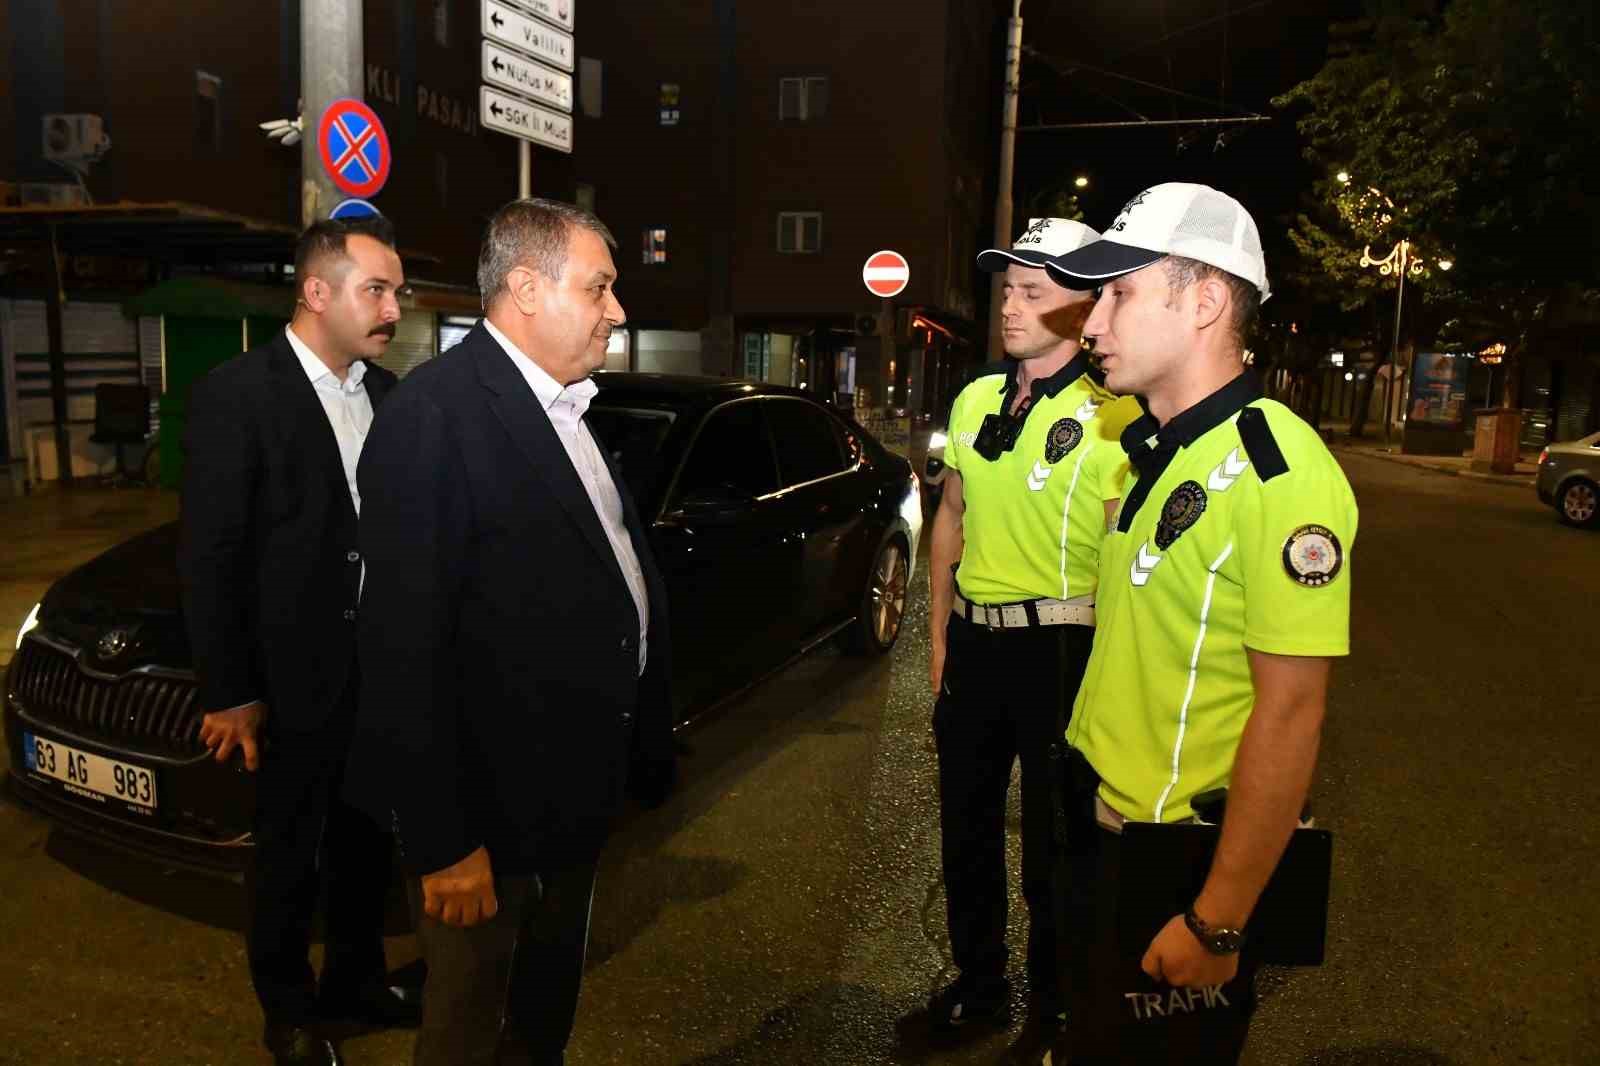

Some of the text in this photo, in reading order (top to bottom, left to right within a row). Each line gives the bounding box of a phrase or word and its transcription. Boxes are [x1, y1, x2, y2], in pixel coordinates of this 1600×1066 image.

[504, 107, 529, 127] SGK
[36, 740, 56, 773] 63
[67, 751, 88, 784] AG
[113, 764, 150, 802] 983
